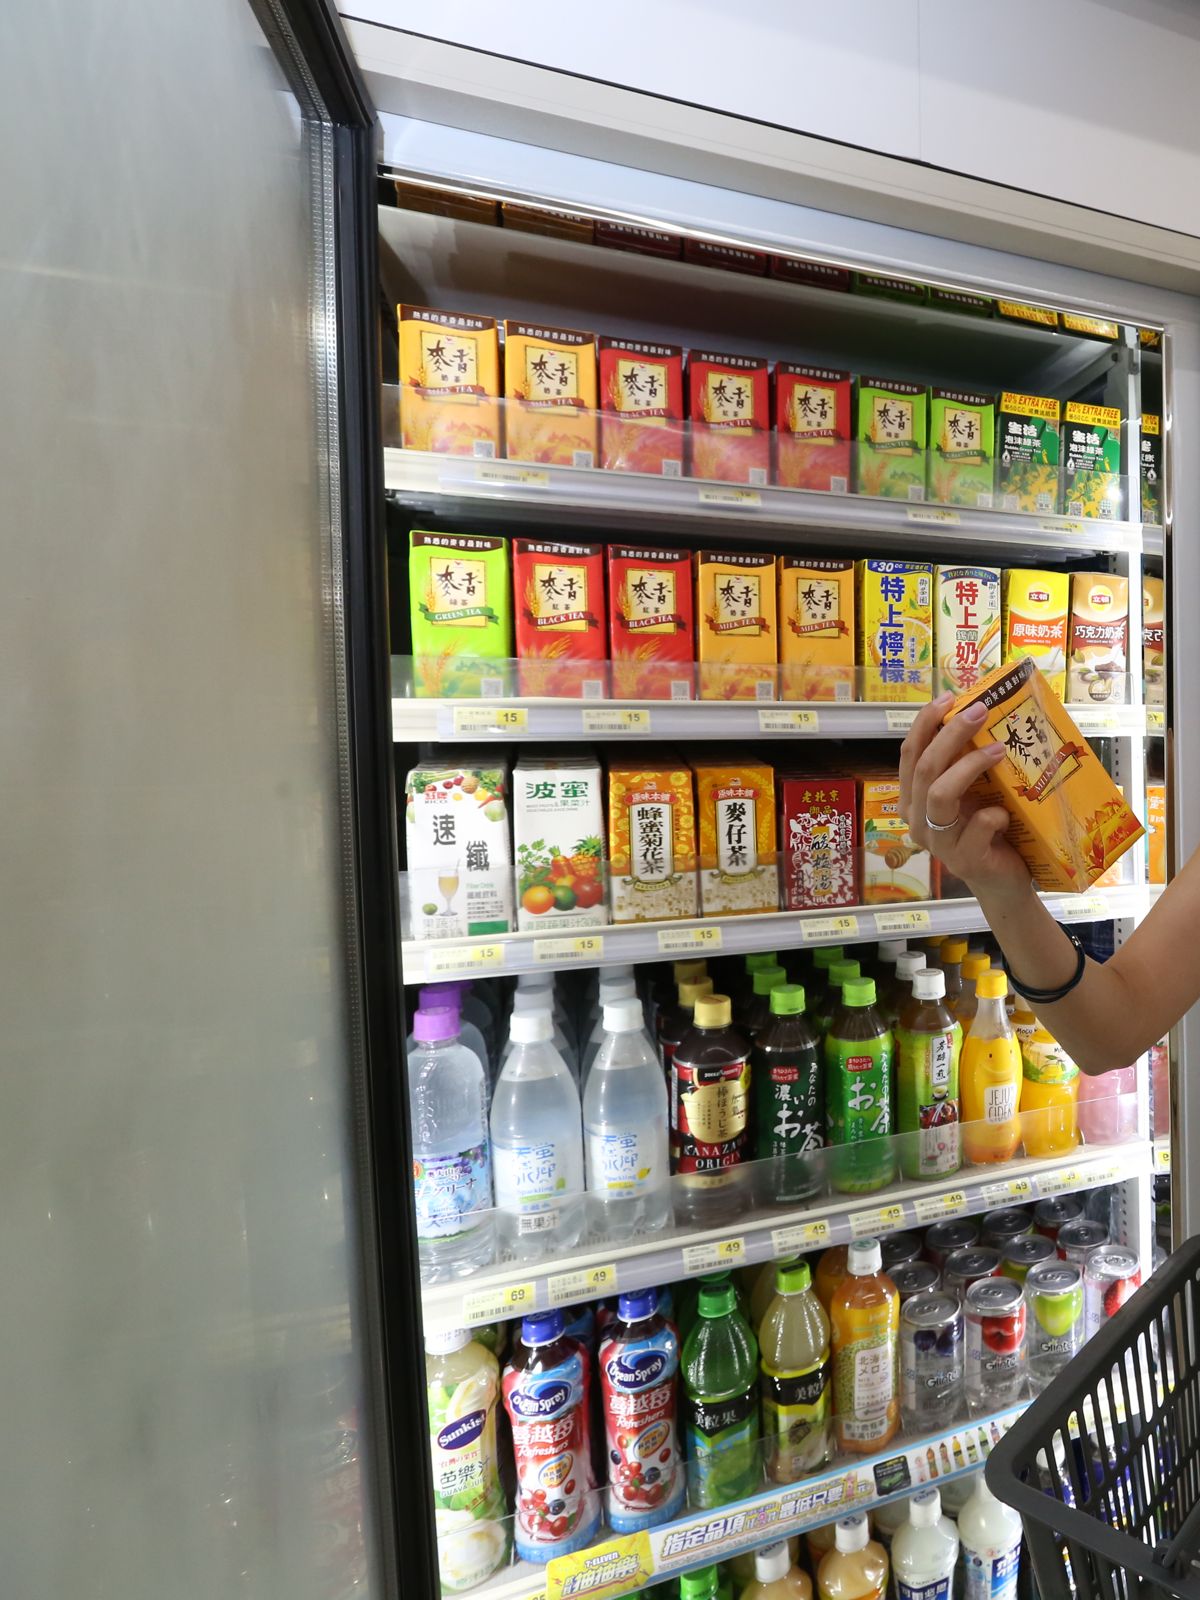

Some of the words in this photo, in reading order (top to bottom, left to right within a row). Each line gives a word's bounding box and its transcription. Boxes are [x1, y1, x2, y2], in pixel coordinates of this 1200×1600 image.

[427, 340, 474, 373] 麥香
[531, 354, 574, 386] 麥香
[623, 367, 663, 398] 麥香
[712, 379, 750, 409] 麥香
[797, 389, 833, 420] 麥香
[1018, 395, 1040, 407] EXTRA
[1040, 399, 1058, 410] FREE
[877, 403, 910, 430] 麥香
[1082, 405, 1102, 416] EXTRA
[1102, 408, 1118, 419] FREE
[948, 414, 979, 440] 麥香
[423, 536, 492, 549] 熟悉的麥香最對味
[527, 543, 591, 555] 熟悉的麥香最對味
[620, 550, 680, 560] 熟悉的麥香最對味
[710, 554, 765, 564] 熟悉的麥香最對味
[437, 565, 482, 597] 麥香
[539, 571, 583, 602] 麥香
[631, 576, 672, 606] 麥香
[719, 580, 757, 609] 麥香
[801, 584, 837, 611] 麥香
[435, 610, 463, 620] GREEN
[465, 608, 481, 616] TEA
[537, 614, 567, 626] BLACK
[568, 611, 584, 621] TEA
[730, 609, 747, 617] 奶茶
[629, 617, 657, 628] BLACK
[658, 614, 673, 623] TEA
[719, 621, 739, 630] MILK
[741, 618, 756, 626] TEA
[800, 623, 820, 632] MILK
[1012, 624, 1063, 639] 原味奶茶
[1075, 625, 1125, 639] 巧克力奶茶
[503, 713, 517, 722] 15
[627, 713, 640, 722] 15
[798, 714, 809, 722] 15
[526, 781, 588, 799] 波蜜
[801, 789, 839, 803] 老北京
[637, 806, 665, 875] 蜂蜜菊花茶
[725, 801, 747, 867] 麥仔茶
[838, 920, 850, 928] 15
[700, 931, 713, 939] 15
[580, 941, 593, 949] 15
[480, 949, 493, 958] 15
[808, 1062, 818, 1107] あなたの
[775, 1084, 805, 1105] 濃い
[988, 1087, 1011, 1106] JEJU
[848, 1076, 890, 1134] お茶
[988, 1105, 1013, 1119] CIDER
[773, 1103, 824, 1161] お茶
[1015, 1182, 1028, 1191] 49
[949, 1194, 963, 1204] 49
[887, 1208, 900, 1218] 49
[521, 1215, 558, 1230] 無果汁
[811, 1224, 825, 1235] 49
[726, 1242, 740, 1252] 49
[592, 1271, 606, 1283] 49
[511, 1289, 525, 1301] 69
[609, 1365, 634, 1383] Ocean
[635, 1358, 662, 1382] Spray
[513, 1395, 539, 1413] Ocean
[540, 1389, 566, 1413] Spray
[610, 1384, 672, 1415] 蔓越莓
[616, 1409, 665, 1428] Refreshers
[695, 1409, 737, 1430] 美粒果
[440, 1413, 485, 1447] Sunkist
[513, 1414, 575, 1445] 蔓越莓
[518, 1441, 568, 1458] Refreshers
[440, 1455, 489, 1489] 芭樂汁
[662, 1512, 746, 1557] 指定品項
[585, 1552, 619, 1568] 7-ELEVEN
